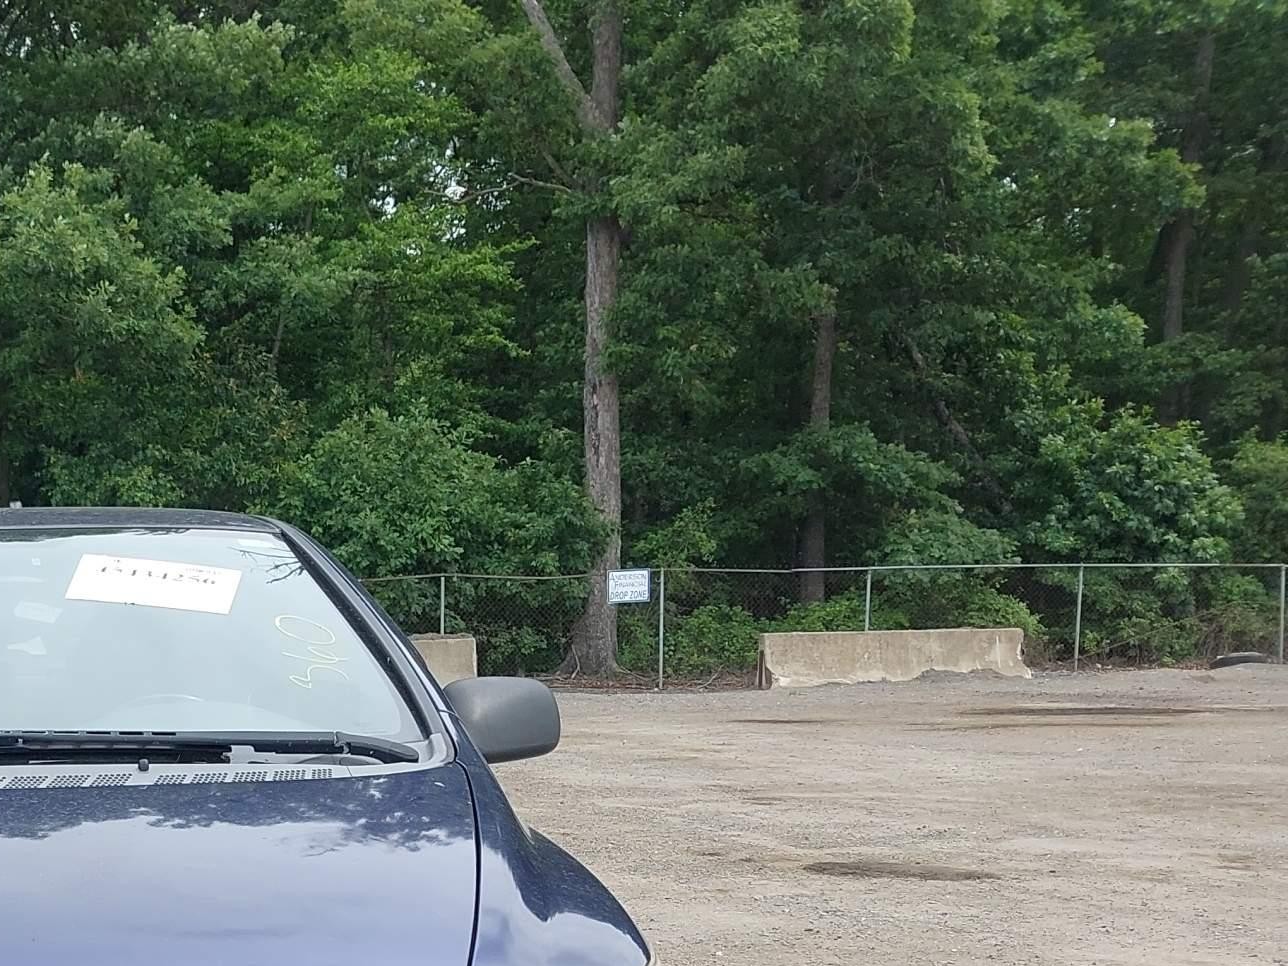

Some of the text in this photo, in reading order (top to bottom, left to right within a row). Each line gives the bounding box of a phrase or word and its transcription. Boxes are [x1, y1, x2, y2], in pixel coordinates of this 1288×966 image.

[610, 572, 647, 581] ANDERSON
[610, 590, 647, 600] DROP ZONE
